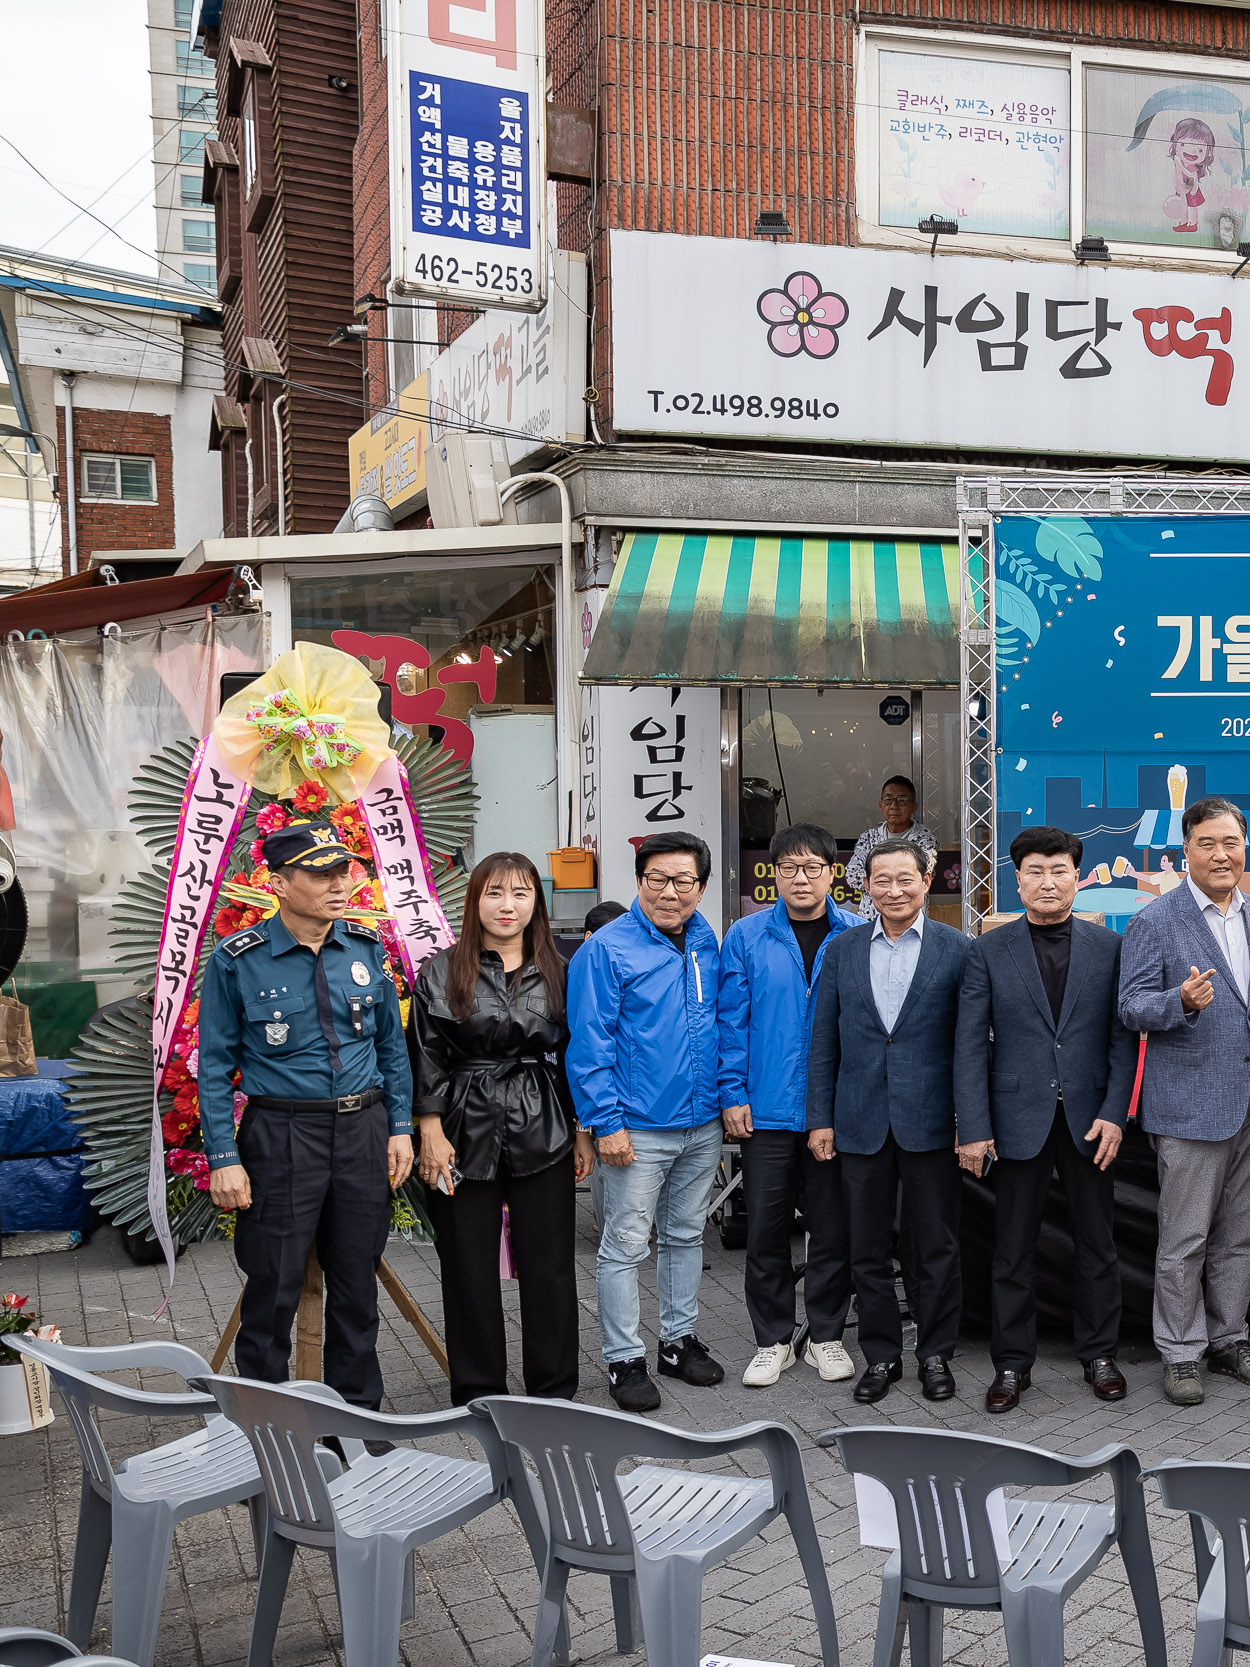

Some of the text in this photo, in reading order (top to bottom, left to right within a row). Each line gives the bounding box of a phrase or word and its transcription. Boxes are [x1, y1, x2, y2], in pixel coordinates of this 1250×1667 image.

[897, 89, 949, 115] 클래식,
[1001, 102, 1057, 125] 실용음악
[889, 118, 1065, 153] 교회반주, 리코더, 관현악
[415, 253, 533, 295] 462-5253
[884, 704, 906, 716] ADT
